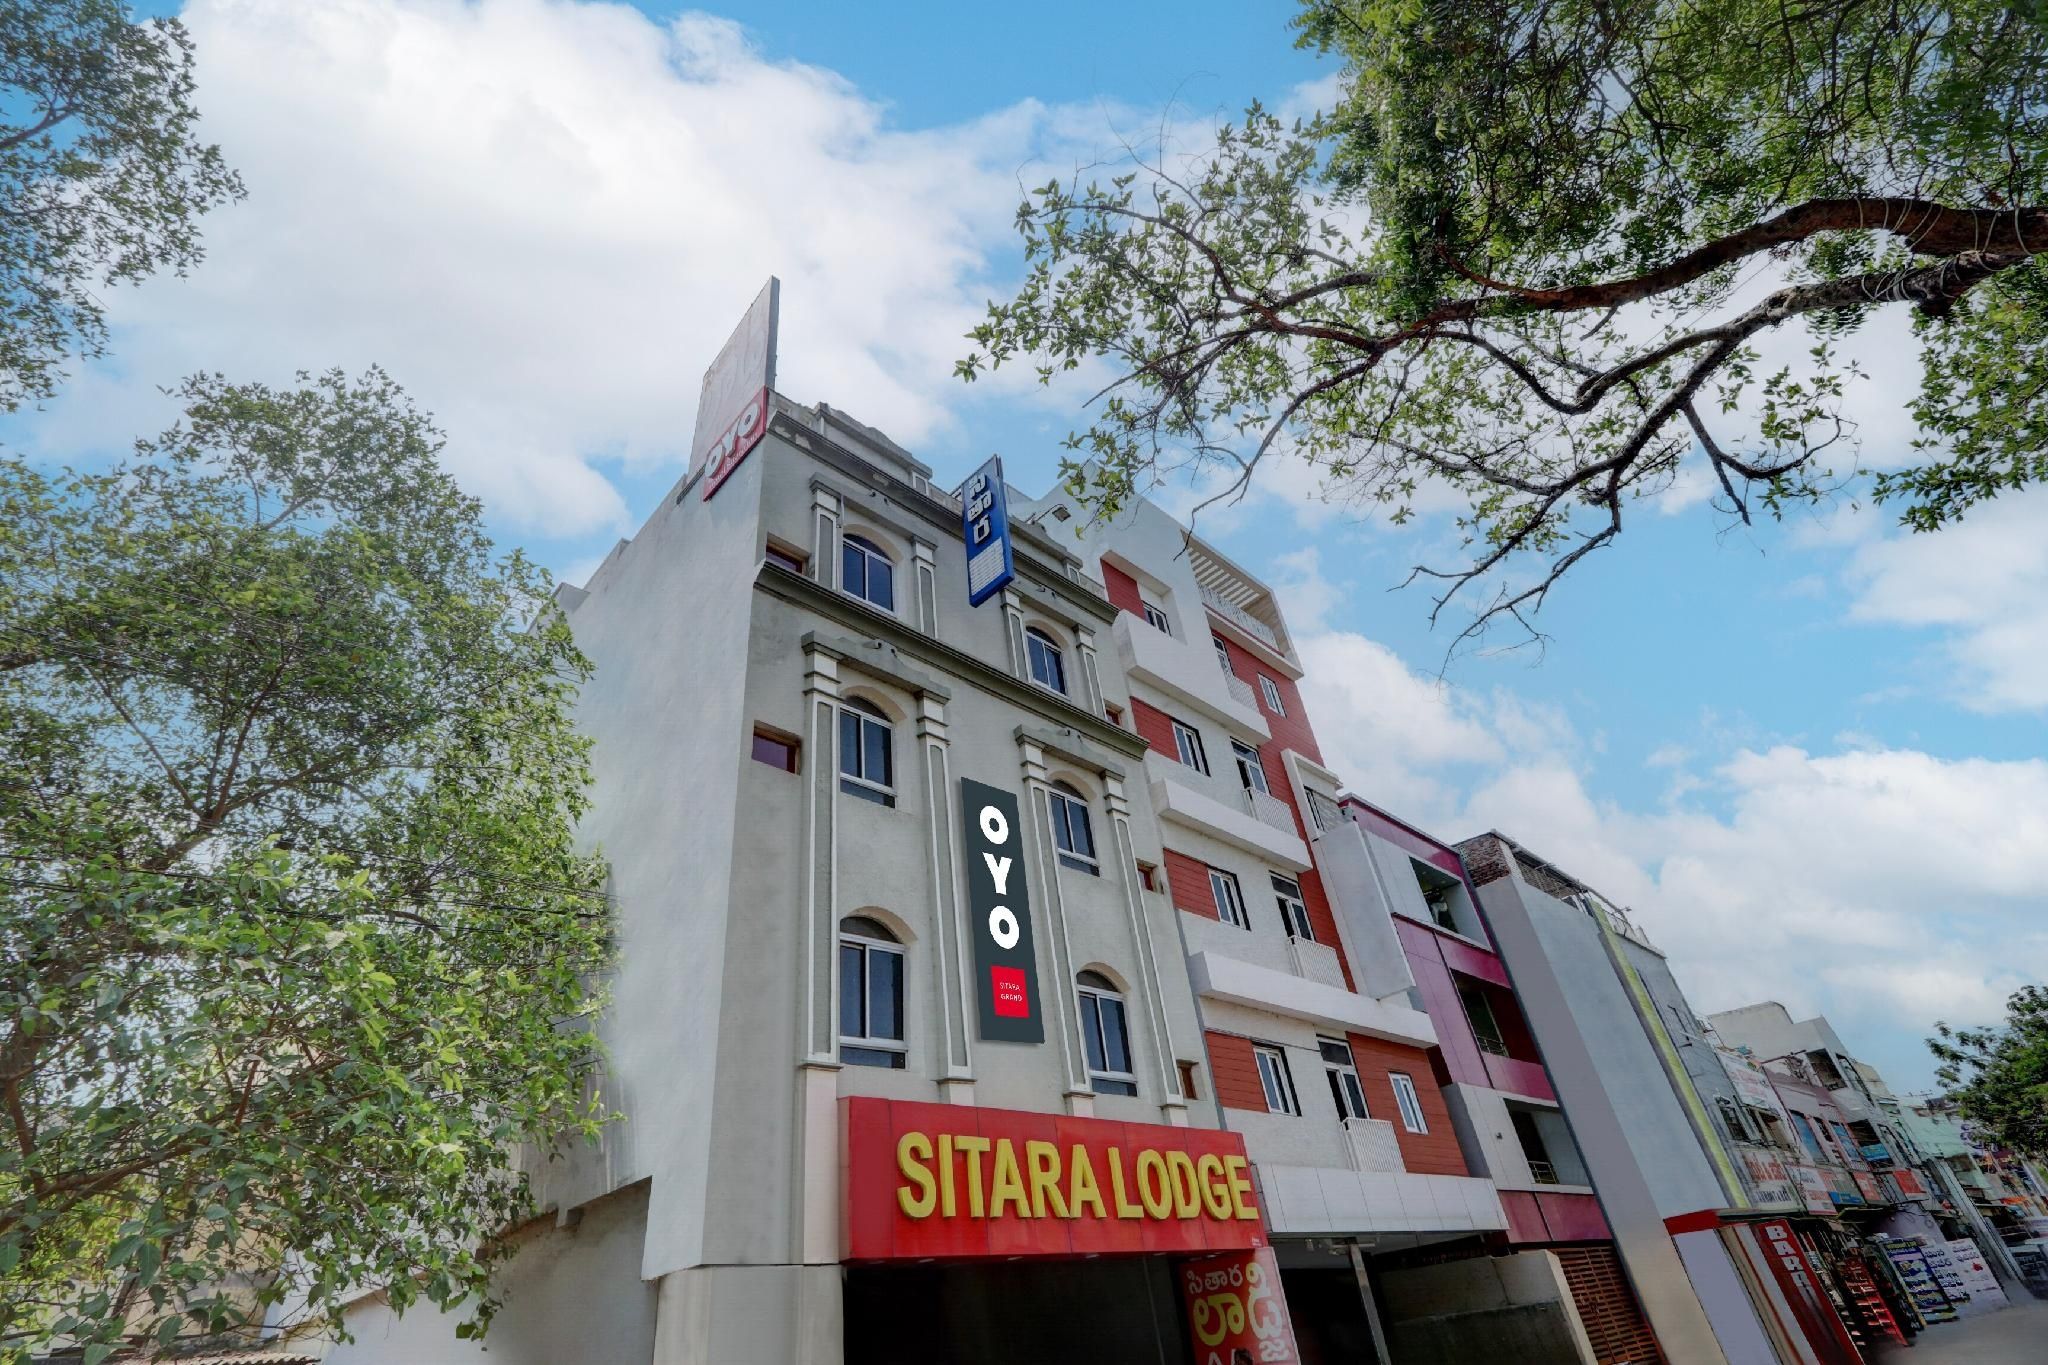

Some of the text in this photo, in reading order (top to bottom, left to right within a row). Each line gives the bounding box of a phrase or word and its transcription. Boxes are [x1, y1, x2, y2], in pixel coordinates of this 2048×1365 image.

[704, 403, 758, 478] OYO
[979, 805, 1020, 949] OYO
[1000, 993, 1023, 1002] GRAND
[896, 1131, 1259, 1220] SITARA LODGE
